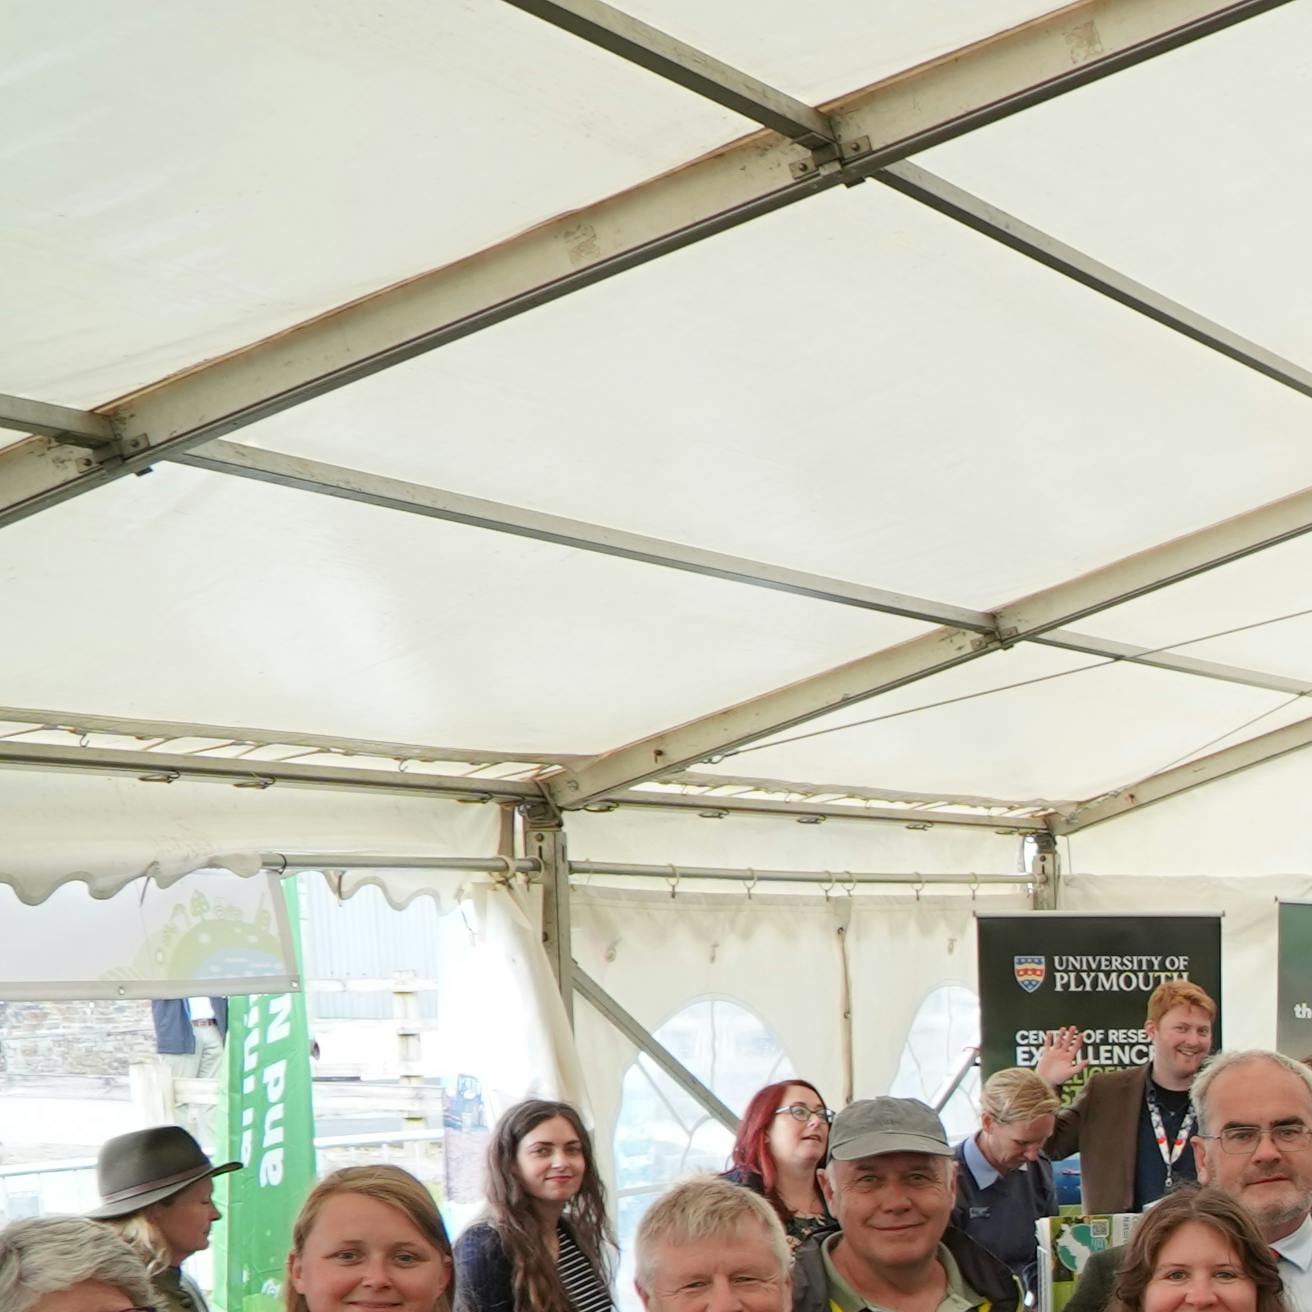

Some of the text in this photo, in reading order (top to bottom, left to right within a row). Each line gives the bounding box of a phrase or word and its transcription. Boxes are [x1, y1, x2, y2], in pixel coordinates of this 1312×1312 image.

[1054, 956, 1189, 971] UNIVERSITY OF
[1083, 1029, 1104, 1044] OF
